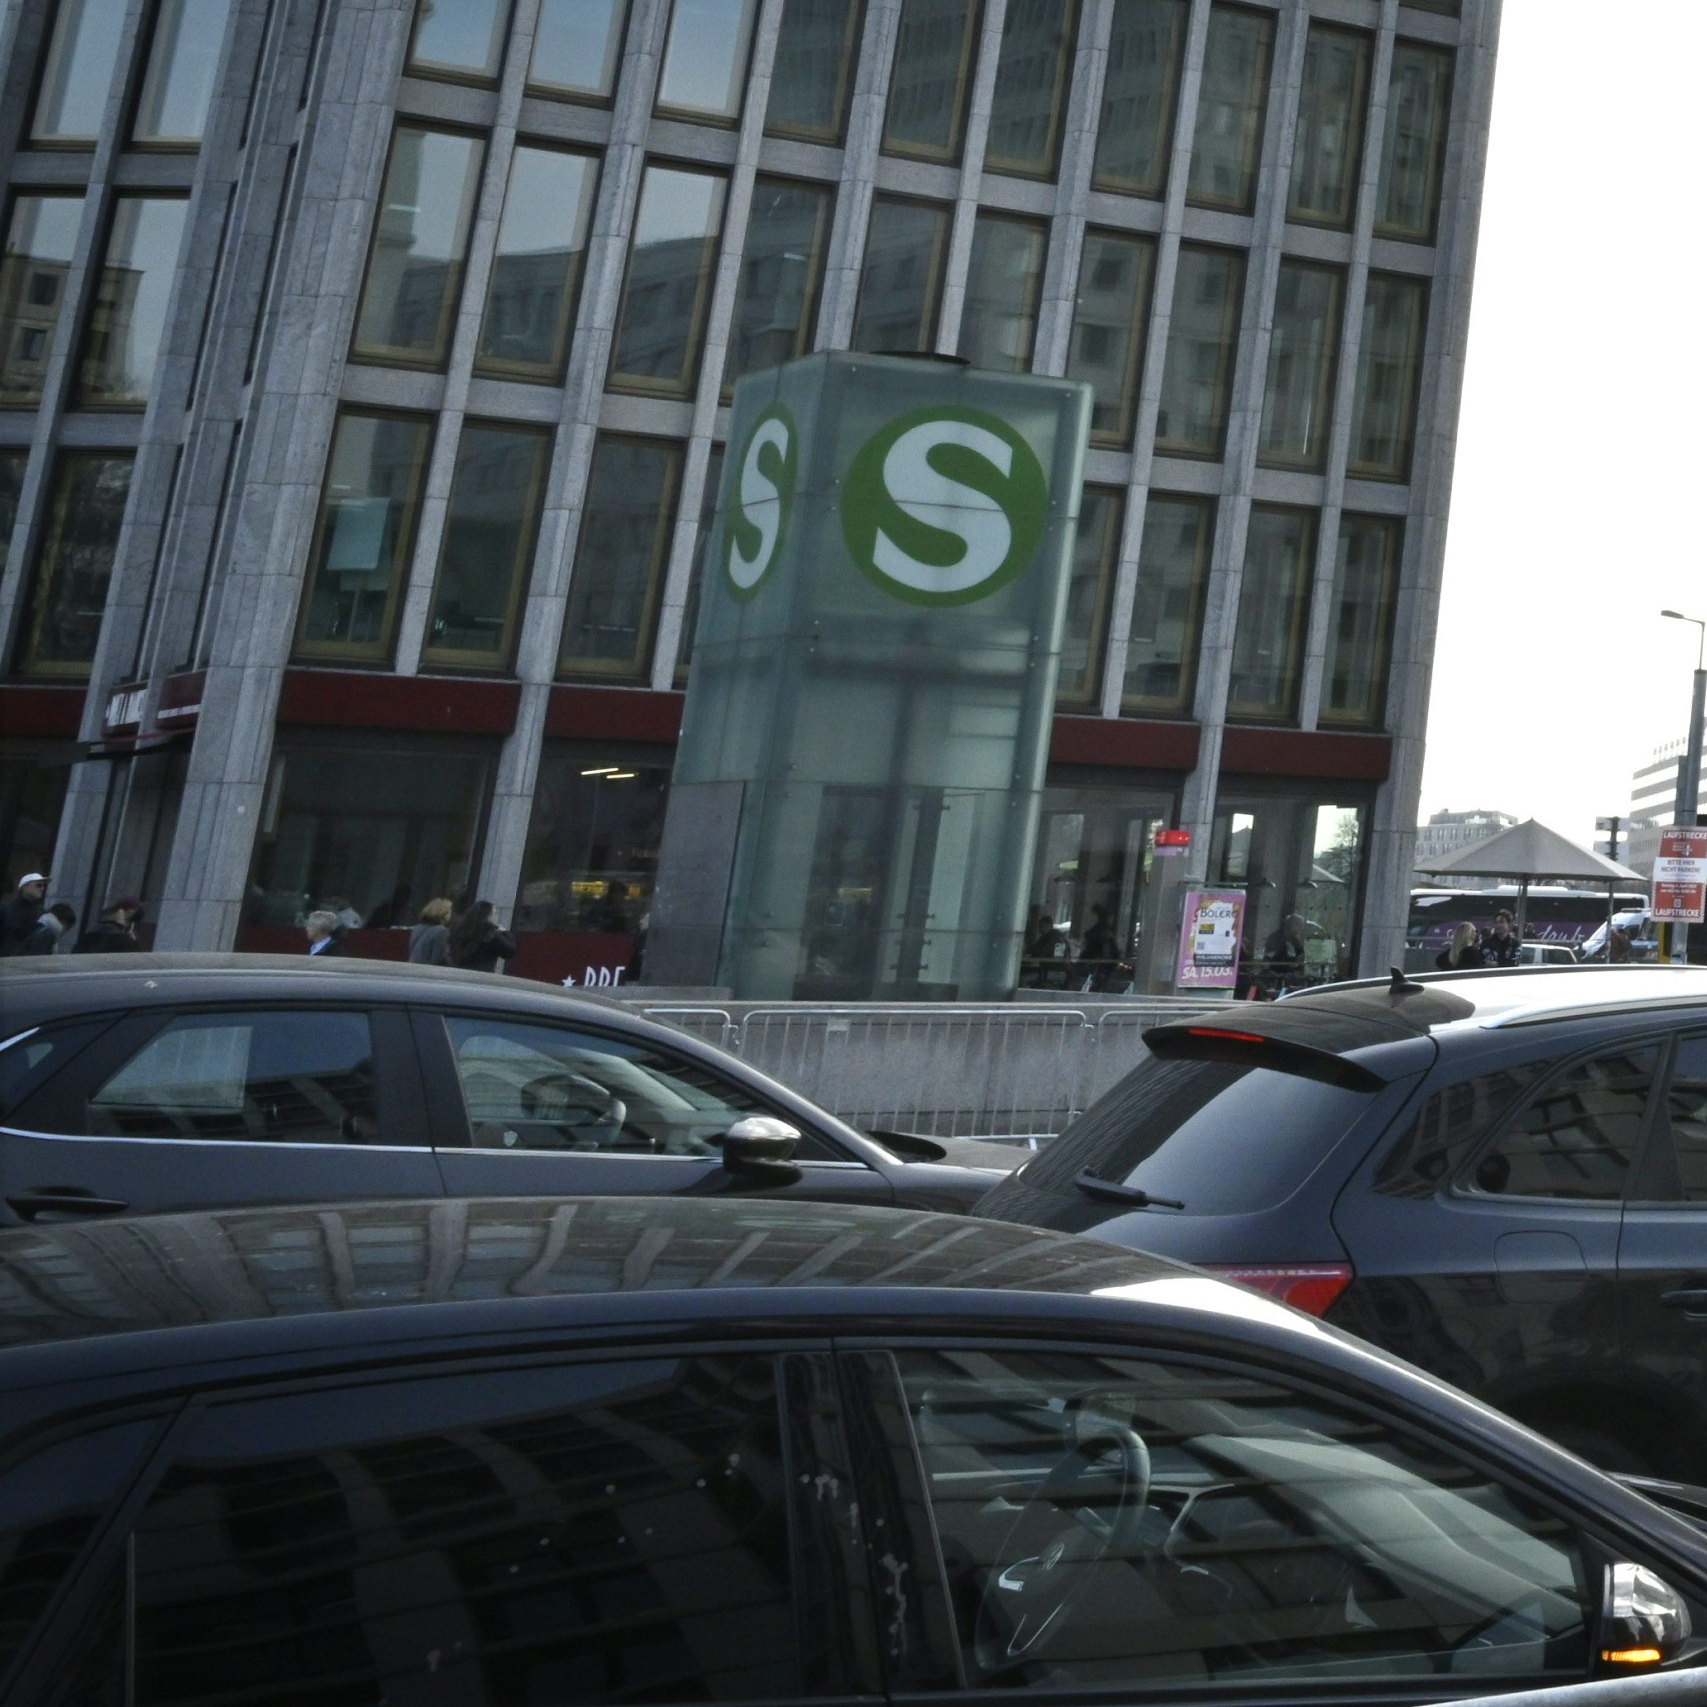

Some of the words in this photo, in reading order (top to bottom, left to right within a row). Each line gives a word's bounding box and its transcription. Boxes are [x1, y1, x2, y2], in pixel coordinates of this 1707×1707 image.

[728, 418, 789, 589] S
[872, 420, 1014, 593] S
[1662, 831, 1707, 840] LAUFSTRECKE
[1200, 908, 1239, 919] BOLERO
[1655, 908, 1700, 917] LAUFSTRECKE
